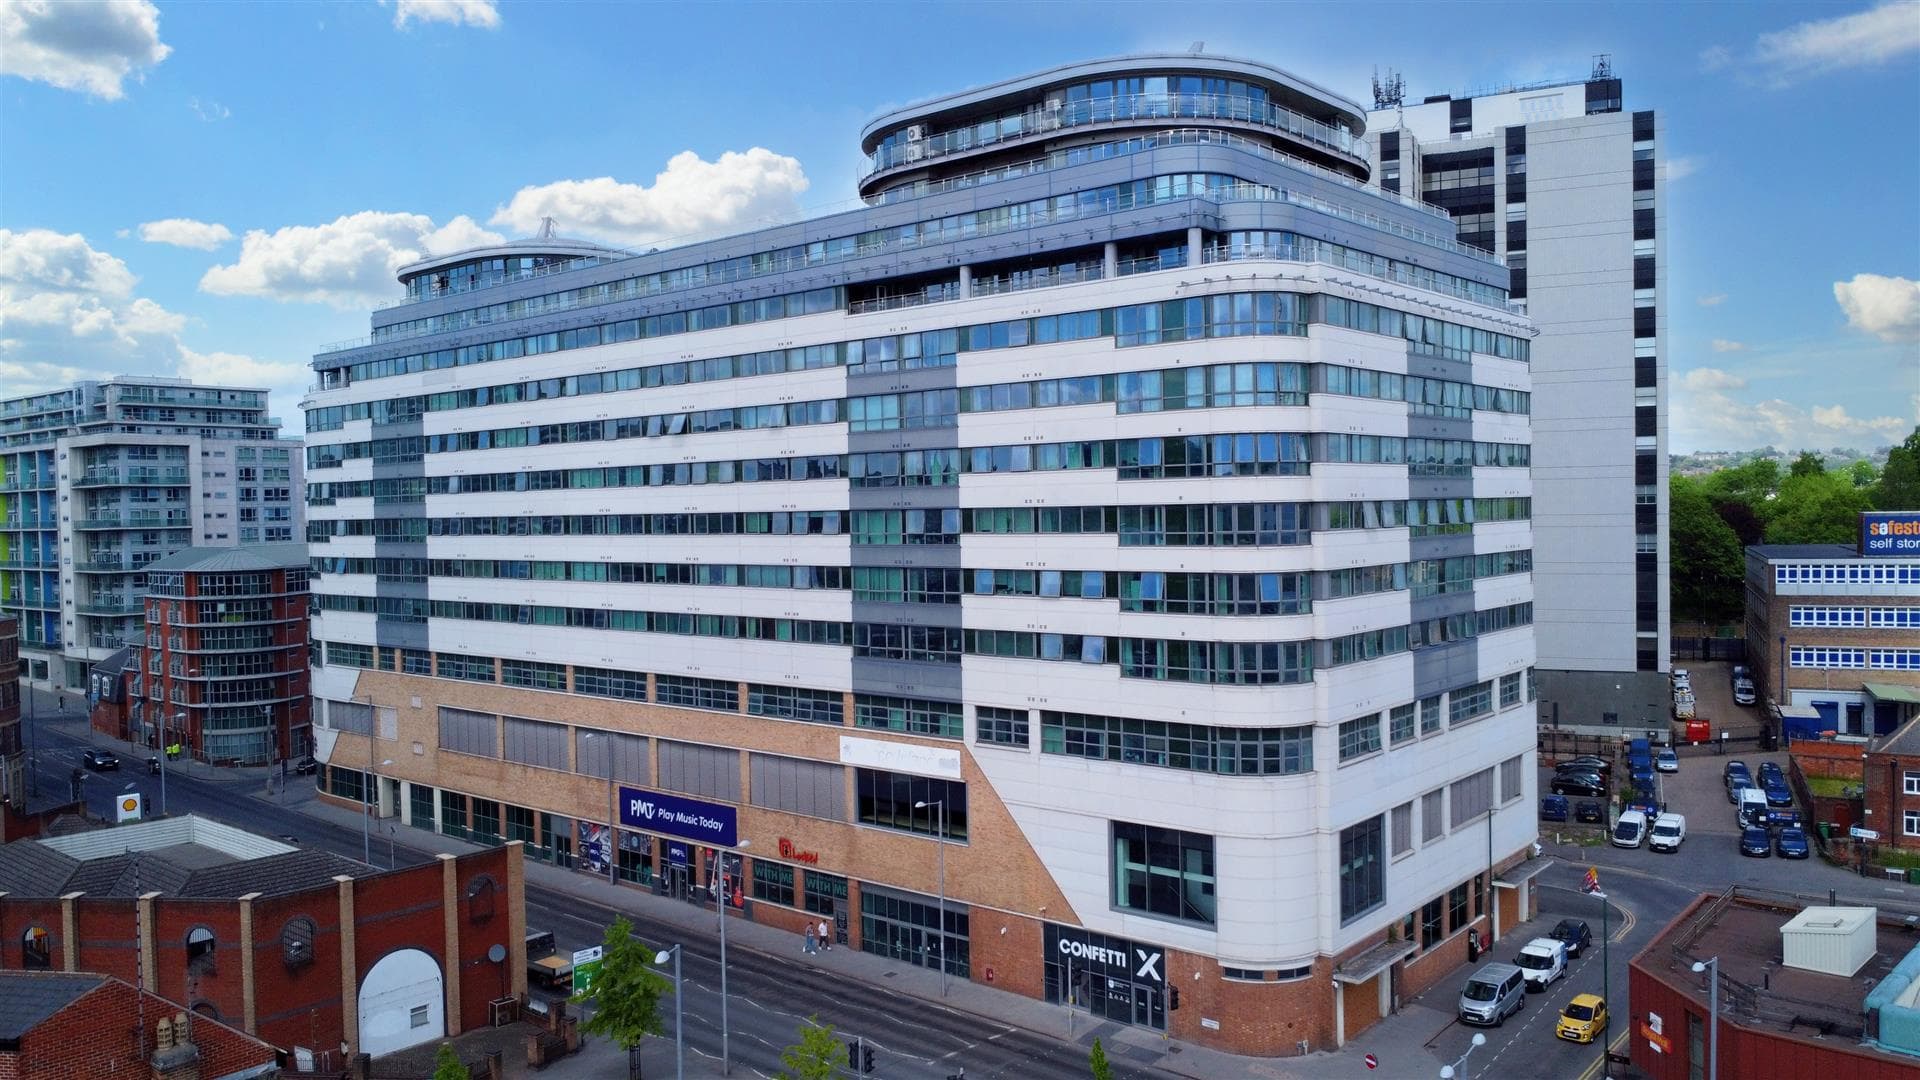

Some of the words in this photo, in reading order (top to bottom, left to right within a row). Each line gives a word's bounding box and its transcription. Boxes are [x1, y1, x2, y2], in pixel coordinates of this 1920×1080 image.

[1870, 520, 1920, 536] safest
[1870, 538, 1893, 549] self
[631, 799, 656, 819] PMT
[658, 807, 675, 823] Play
[676, 811, 698, 826] Music
[699, 815, 724, 832] Today
[780, 870, 793, 884] ME
[834, 882, 847, 897] ME
[1060, 938, 1126, 968] CONFETTI
[1136, 948, 1162, 981] X
